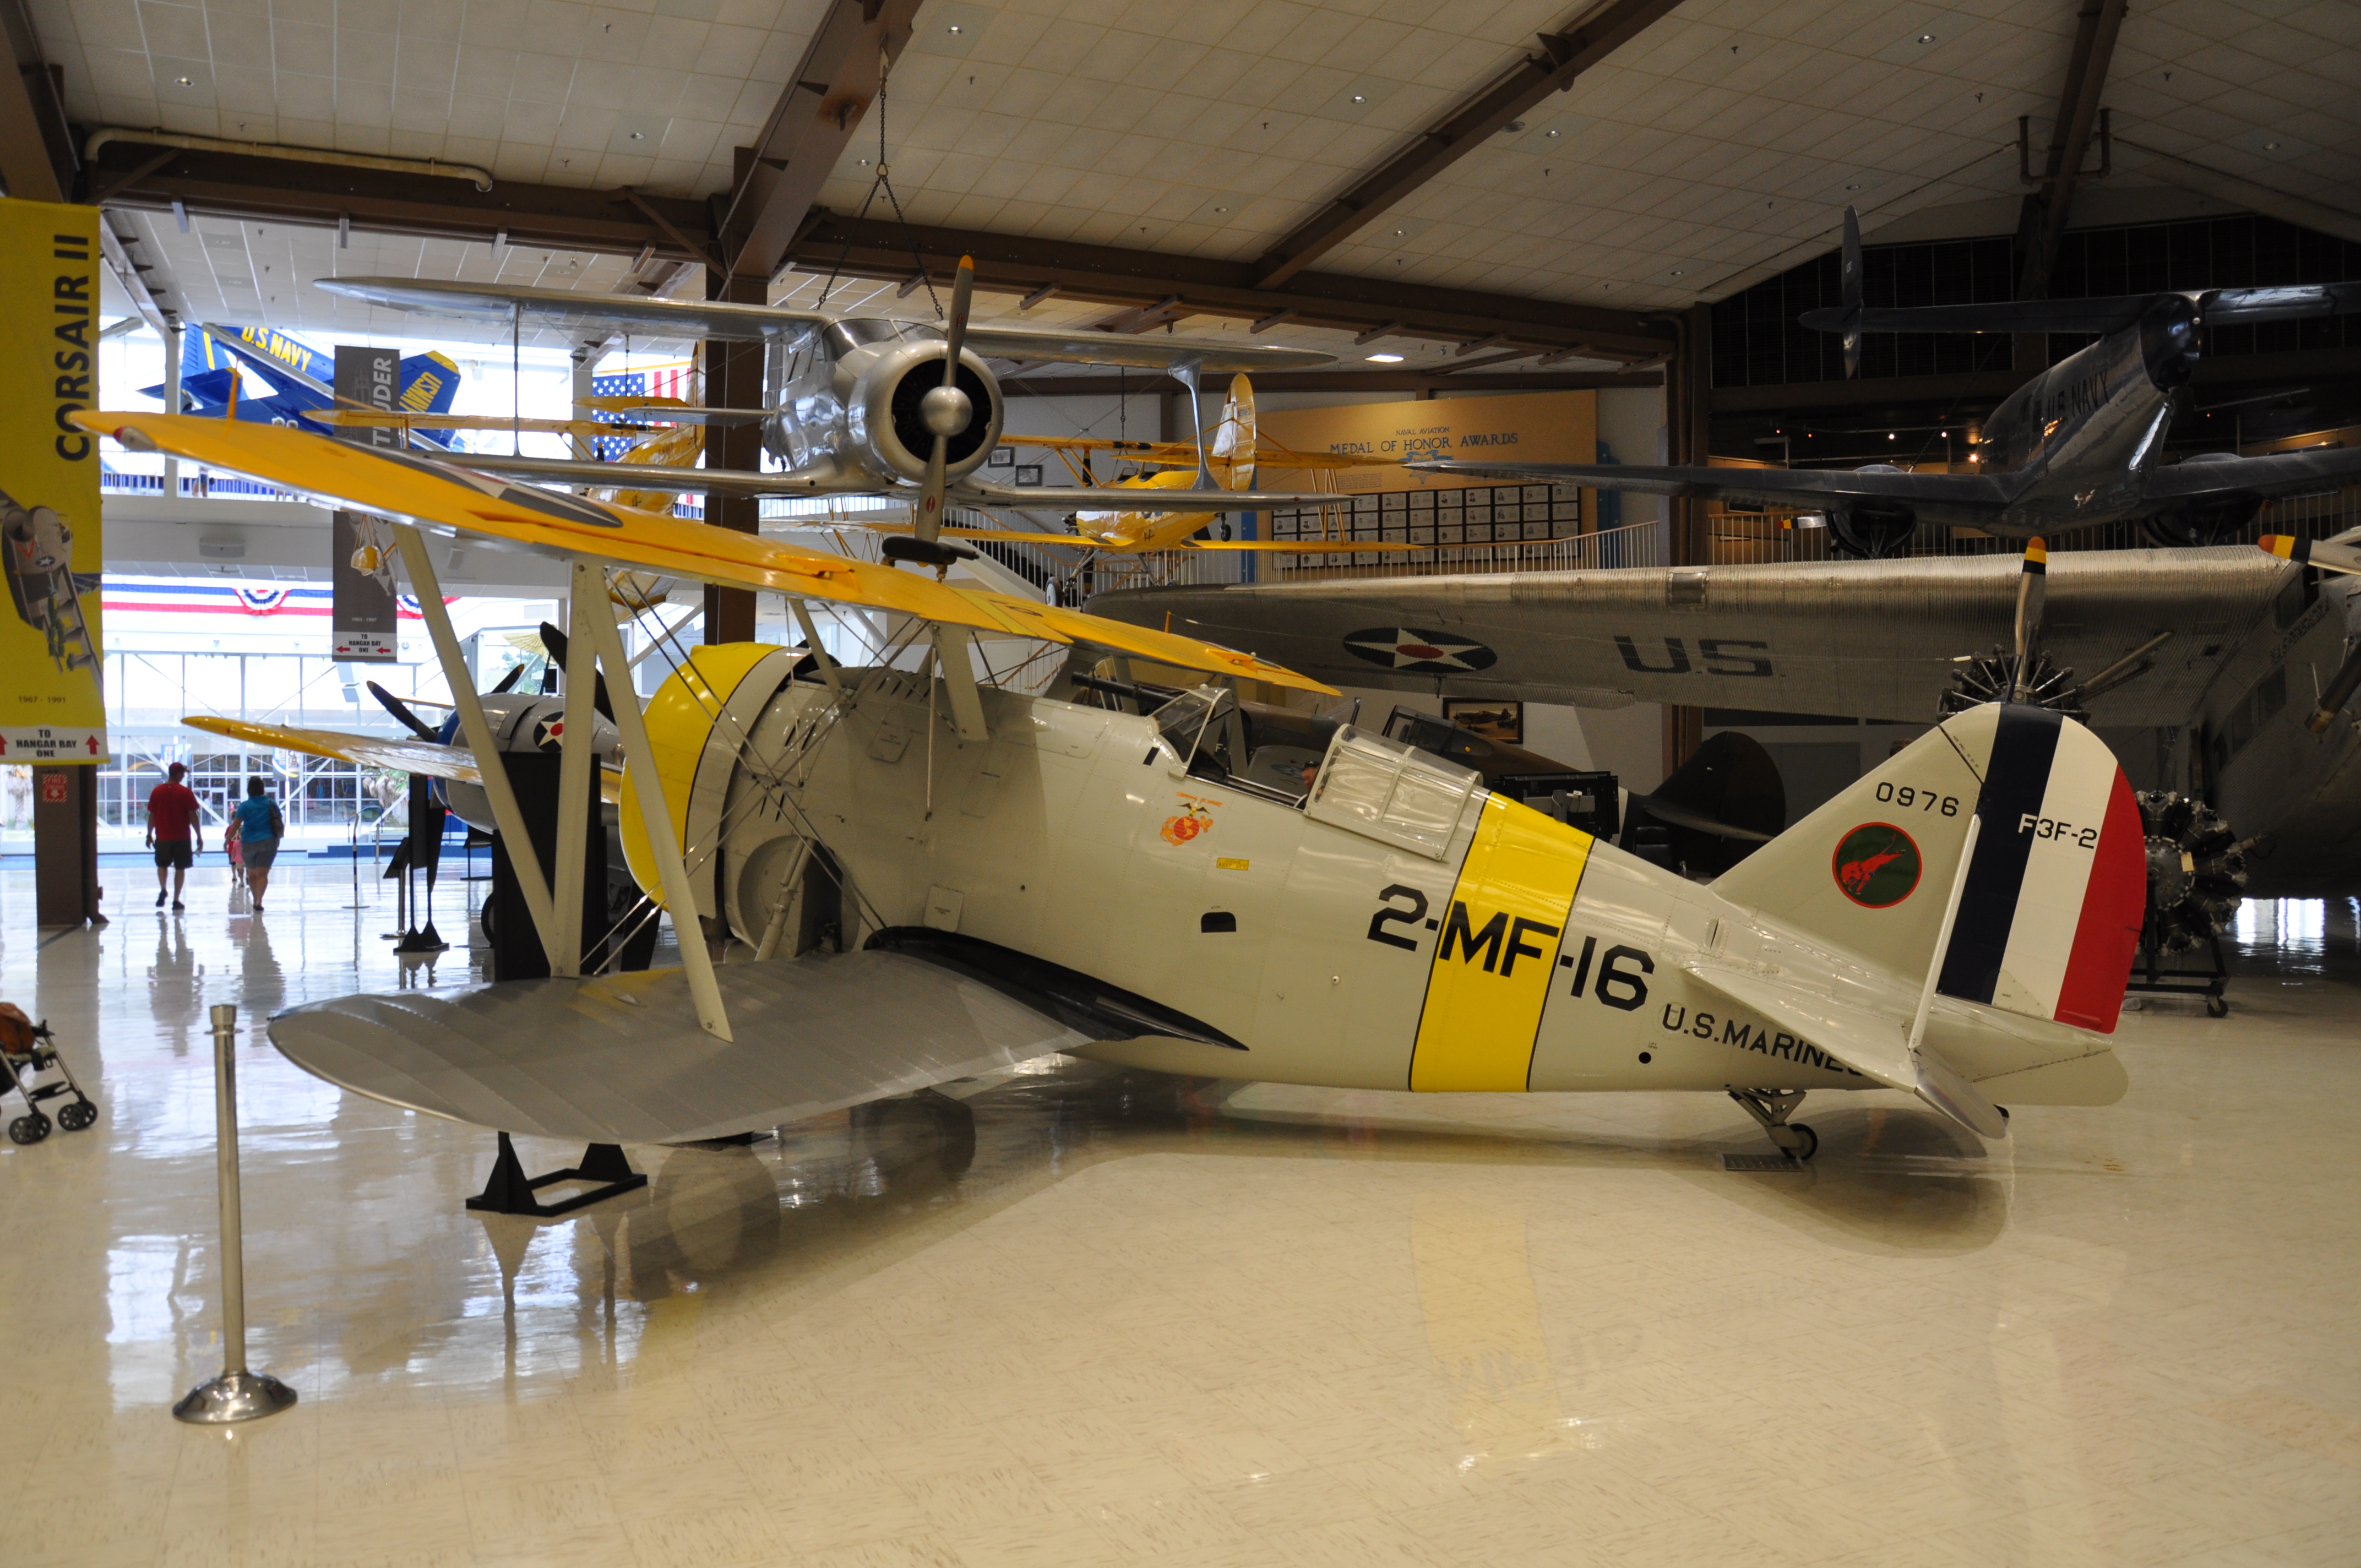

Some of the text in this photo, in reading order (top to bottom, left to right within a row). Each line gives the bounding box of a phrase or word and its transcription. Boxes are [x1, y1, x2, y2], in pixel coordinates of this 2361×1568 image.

[55, 276, 90, 461] CORSAIR
[1330, 433, 1518, 454] MEDAL OF HONOR AWARDS
[1419, 427, 1450, 435] AVIATION
[16, 739, 77, 748] HANGAR BAY
[38, 729, 51, 738] TO
[1875, 781, 1959, 817] 0976
[2018, 813, 2098, 850] F3F-2
[1662, 1004, 1863, 1076] U.S.MARINE
